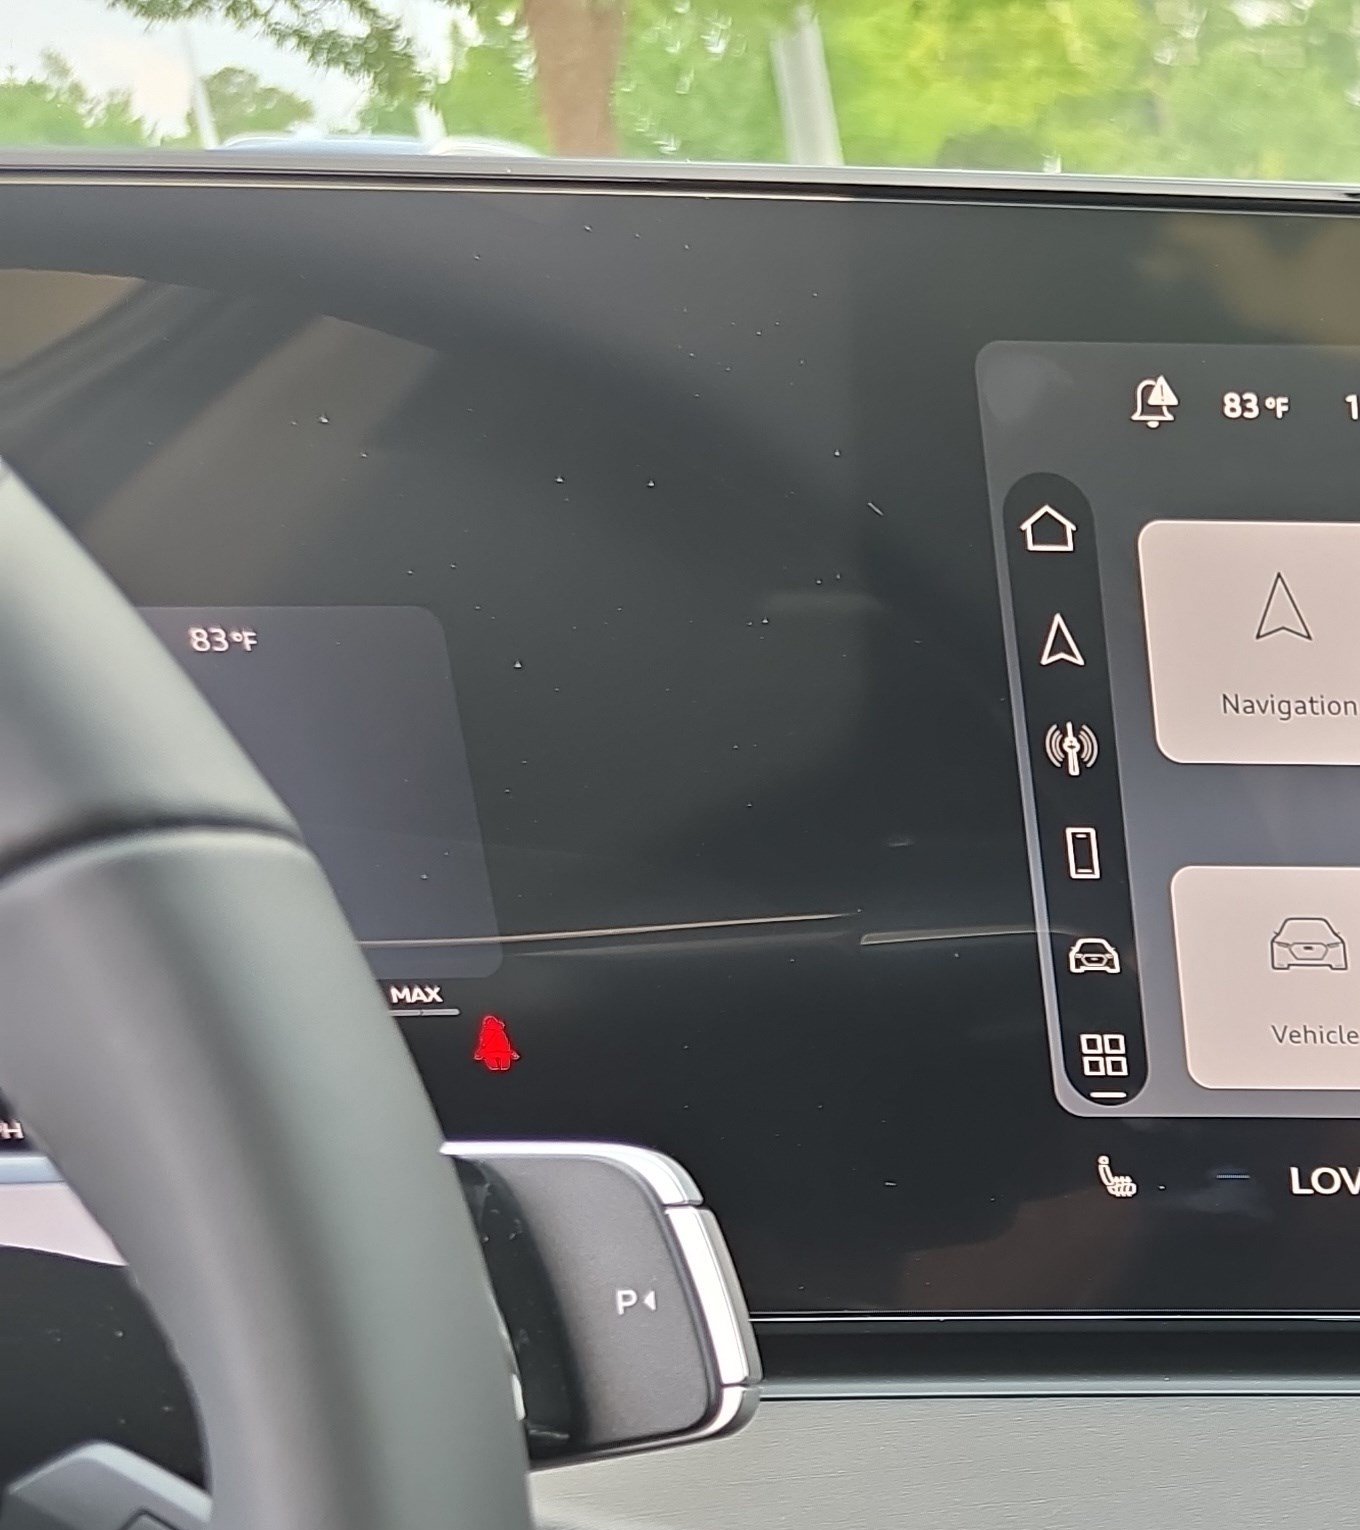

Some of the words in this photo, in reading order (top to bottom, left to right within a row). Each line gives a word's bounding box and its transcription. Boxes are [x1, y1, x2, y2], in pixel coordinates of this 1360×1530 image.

[1222, 693, 1358, 721] Navigation
[389, 985, 444, 1004] MAX
[1271, 1024, 1359, 1045] Vehicle
[615, 1289, 637, 1315] P
